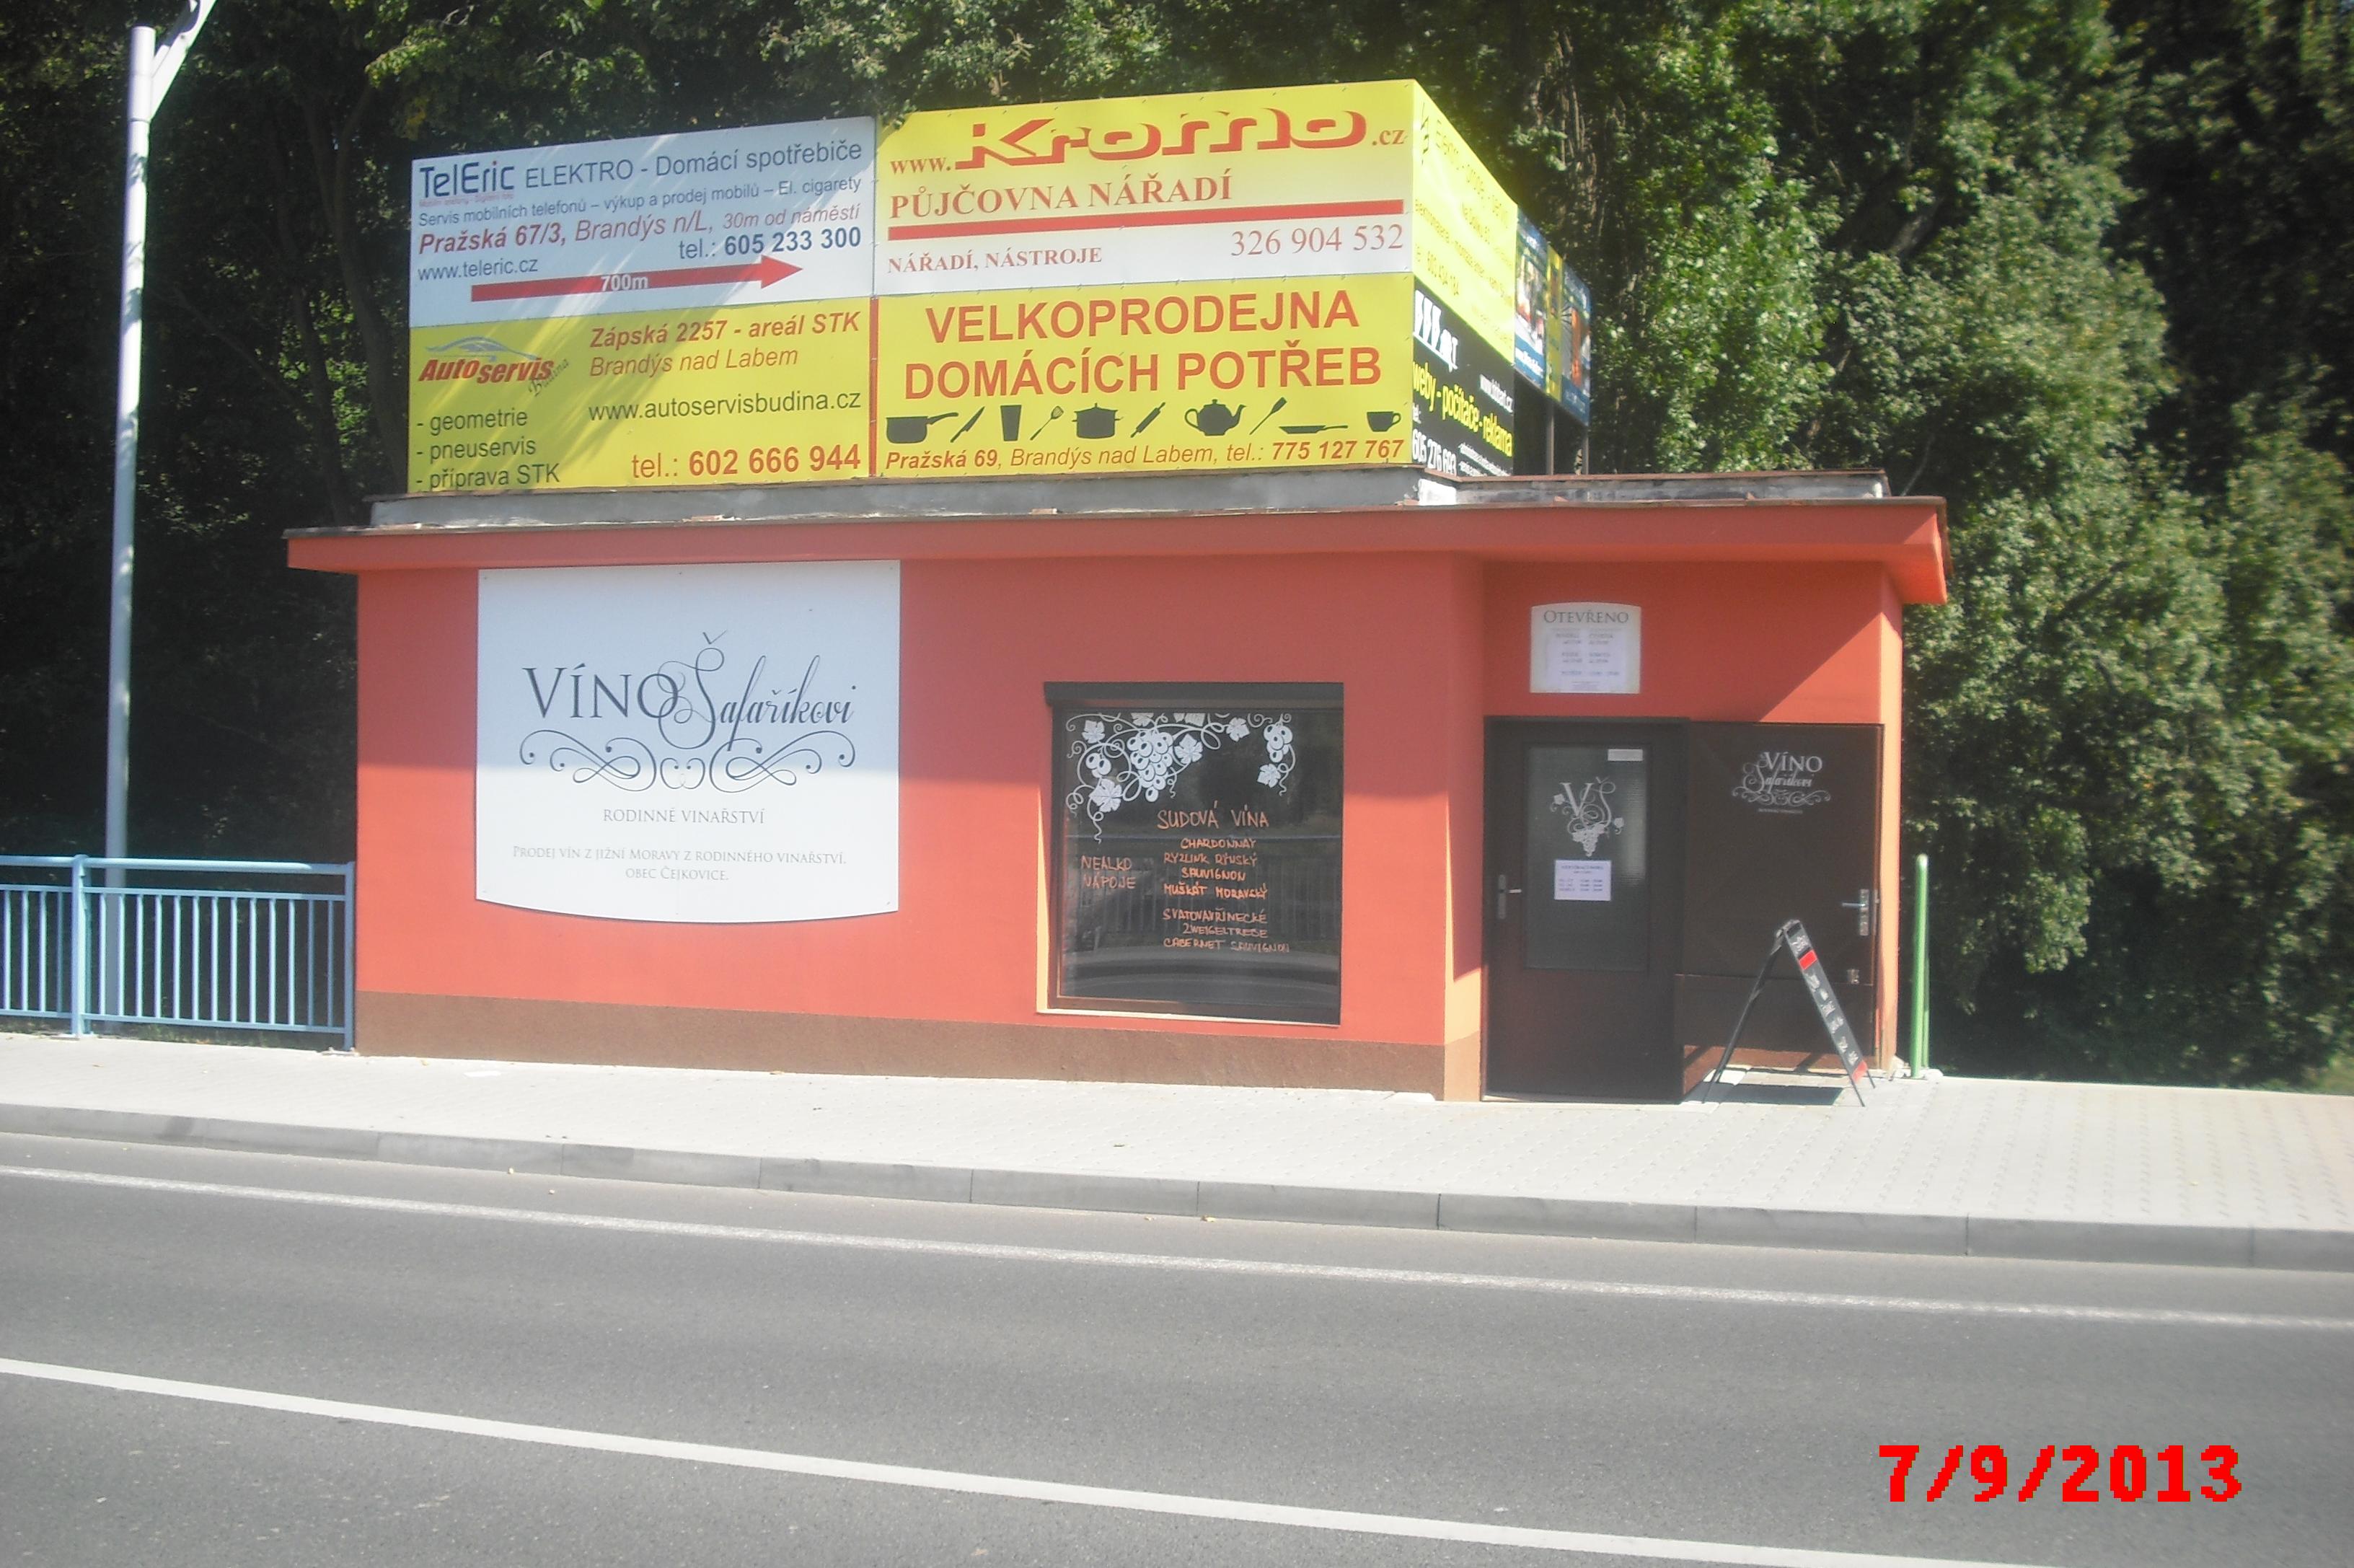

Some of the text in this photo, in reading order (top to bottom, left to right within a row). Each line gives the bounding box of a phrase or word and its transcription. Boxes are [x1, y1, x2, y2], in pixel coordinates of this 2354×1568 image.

[419, 161, 515, 198] TelEric
[526, 159, 633, 188] ELEKTRO
[656, 149, 738, 176] Domácí
[746, 139, 862, 172] spotřebiče
[419, 212, 459, 226] Servis
[464, 204, 527, 222] mobilních
[532, 199, 586, 216] telefonů
[604, 195, 645, 212] výkup
[649, 196, 658, 206] a
[663, 188, 707, 208] prodej
[711, 183, 759, 201] mobilů
[780, 180, 796, 195] El.
[803, 177, 861, 195] cigarety
[889, 168, 1233, 219] PŮJČOVNA NÁŘADÍ
[419, 203, 861, 255] Pražská 67/3, Brandýs n/L, 30m od náměstí
[679, 226, 861, 259] tel.: 605 233 300
[1231, 224, 1403, 256] 326 904 532
[418, 257, 539, 281] www.teleric.cz
[888, 247, 1102, 274] NÁŘADÍ, NÁSTROJE
[600, 273, 649, 291] 700m
[925, 290, 1359, 343] VELKOPRODEJNA
[590, 323, 668, 351] Zápská
[676, 320, 728, 342] 2257
[749, 315, 804, 337] areál
[812, 312, 860, 335] STK
[418, 358, 554, 384] Autoservis
[589, 348, 798, 377] Brandýs nad Labem
[905, 340, 1382, 400] DOMÁCÍCH POTŘEB
[588, 390, 860, 420] www.autoservisbudina.cz
[1413, 361, 1437, 412] weby
[1483, 413, 1512, 457] reklama
[430, 408, 528, 436] geometrie
[430, 436, 537, 464] pneuservis
[632, 444, 861, 478] tel.: 602 666 944
[886, 439, 1405, 470] Pražská 69, Brandýs nad Labem, tel.: 775 127 767
[430, 467, 509, 490] příprava
[517, 463, 560, 485] STK
[522, 662, 679, 719] VÍNO
[1763, 752, 1823, 772] VÍNO
[603, 808, 764, 824] RODINNÉ VINAŘSTVÍ
[1157, 800, 1270, 829] SUDOVÁ VÍNA
[630, 849, 680, 860] MORAVY
[684, 850, 692, 861] Z
[695, 849, 773, 863] RODINNÉHO
[1180, 837, 1257, 850] CHARDONNAY
[1081, 855, 1132, 871] NEALKO
[1163, 852, 1210, 865] RYZLINK
[625, 868, 657, 879] OBEC
[1084, 871, 1137, 889] NÁPOJE
[1181, 867, 1247, 881] SAUVIGNON
[1163, 881, 1208, 896] MUŠKÁT
[1163, 907, 1268, 924] SVATOVAVŘINECKÉ
[1163, 938, 1226, 951] CABERNET
